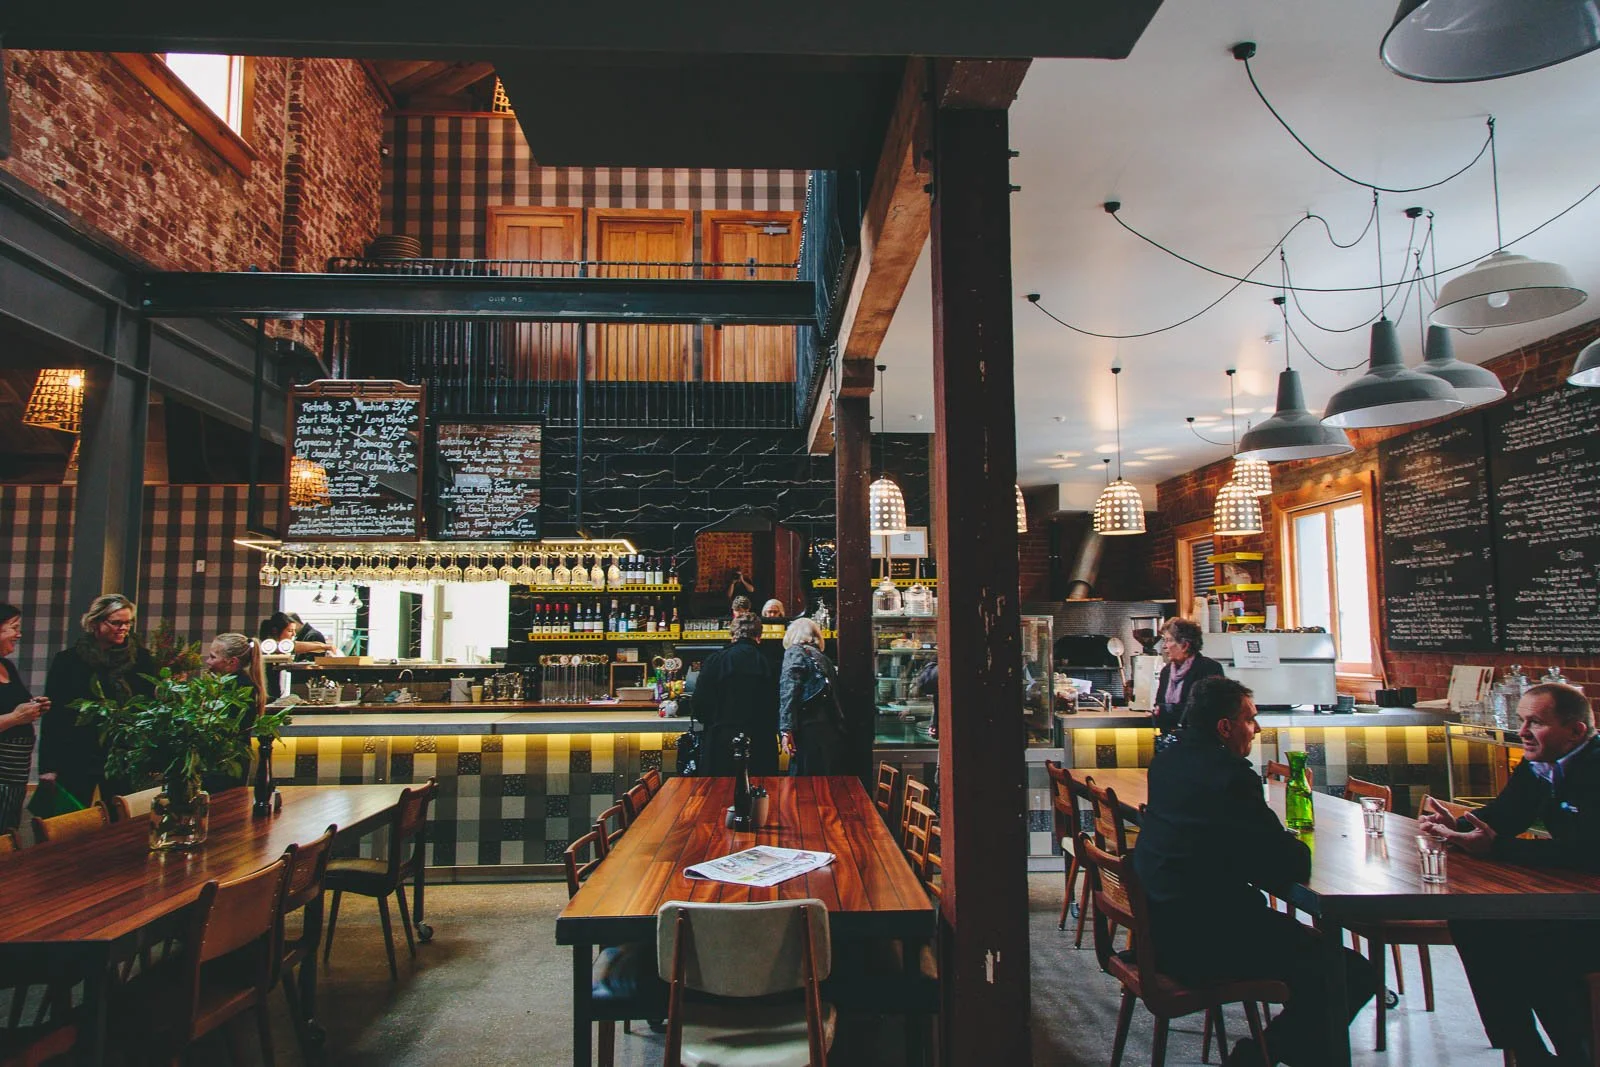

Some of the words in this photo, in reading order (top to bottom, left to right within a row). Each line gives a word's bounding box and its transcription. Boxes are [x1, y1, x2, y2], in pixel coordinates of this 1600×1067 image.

[297, 414, 318, 424] Short
[321, 413, 343, 425] Black
[365, 414, 385, 427] Long
[386, 413, 407, 425] Black
[297, 425, 311, 435] Flat
[455, 504, 466, 513] All
[468, 504, 485, 513] Good
